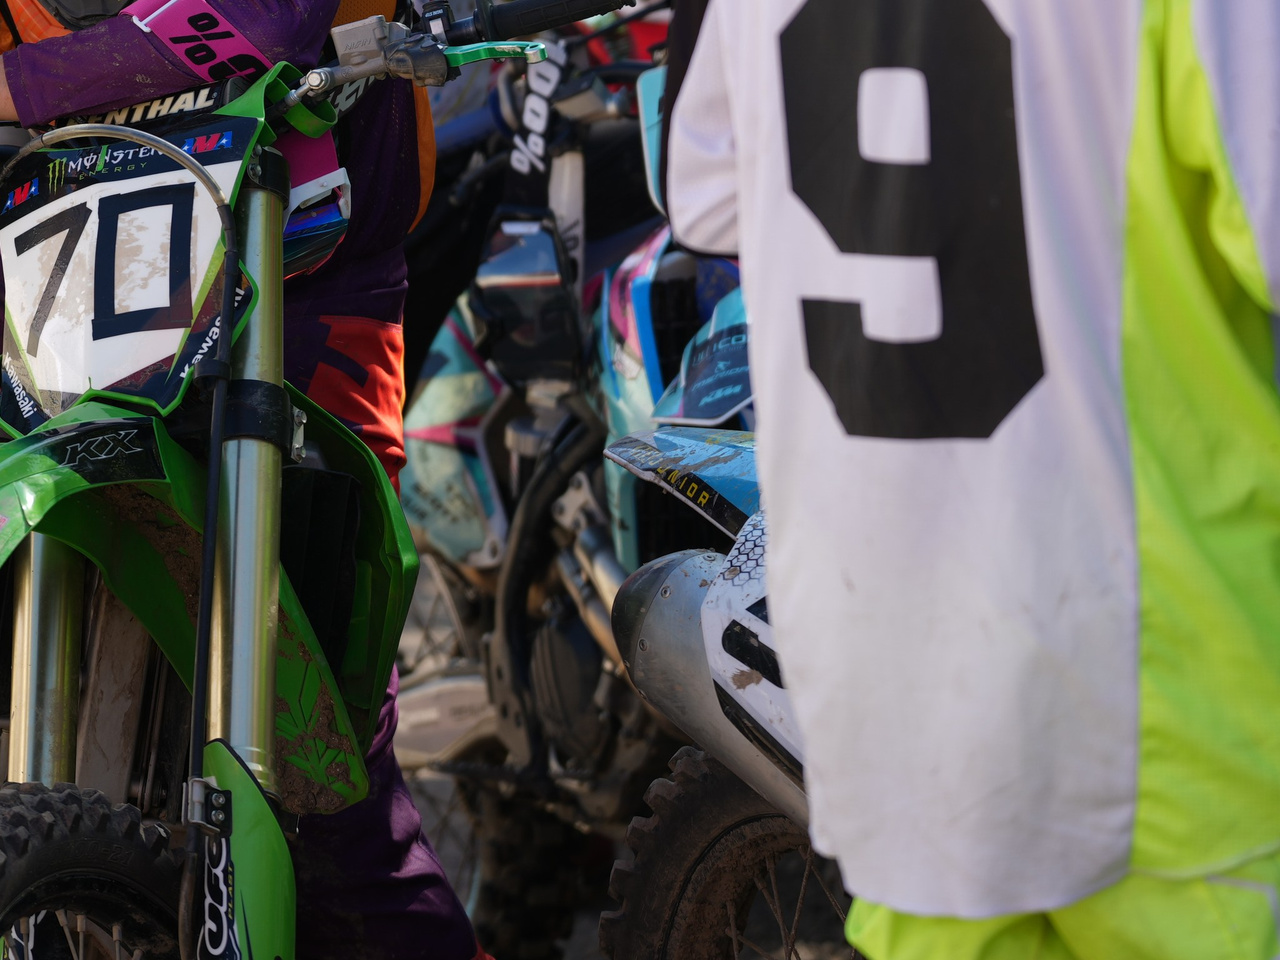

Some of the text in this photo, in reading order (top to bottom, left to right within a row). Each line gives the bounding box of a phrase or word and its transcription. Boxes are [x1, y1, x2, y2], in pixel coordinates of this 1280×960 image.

[14, 181, 196, 358] 70
[1, 351, 34, 419] Kawasaki
[59, 429, 144, 468] KX
